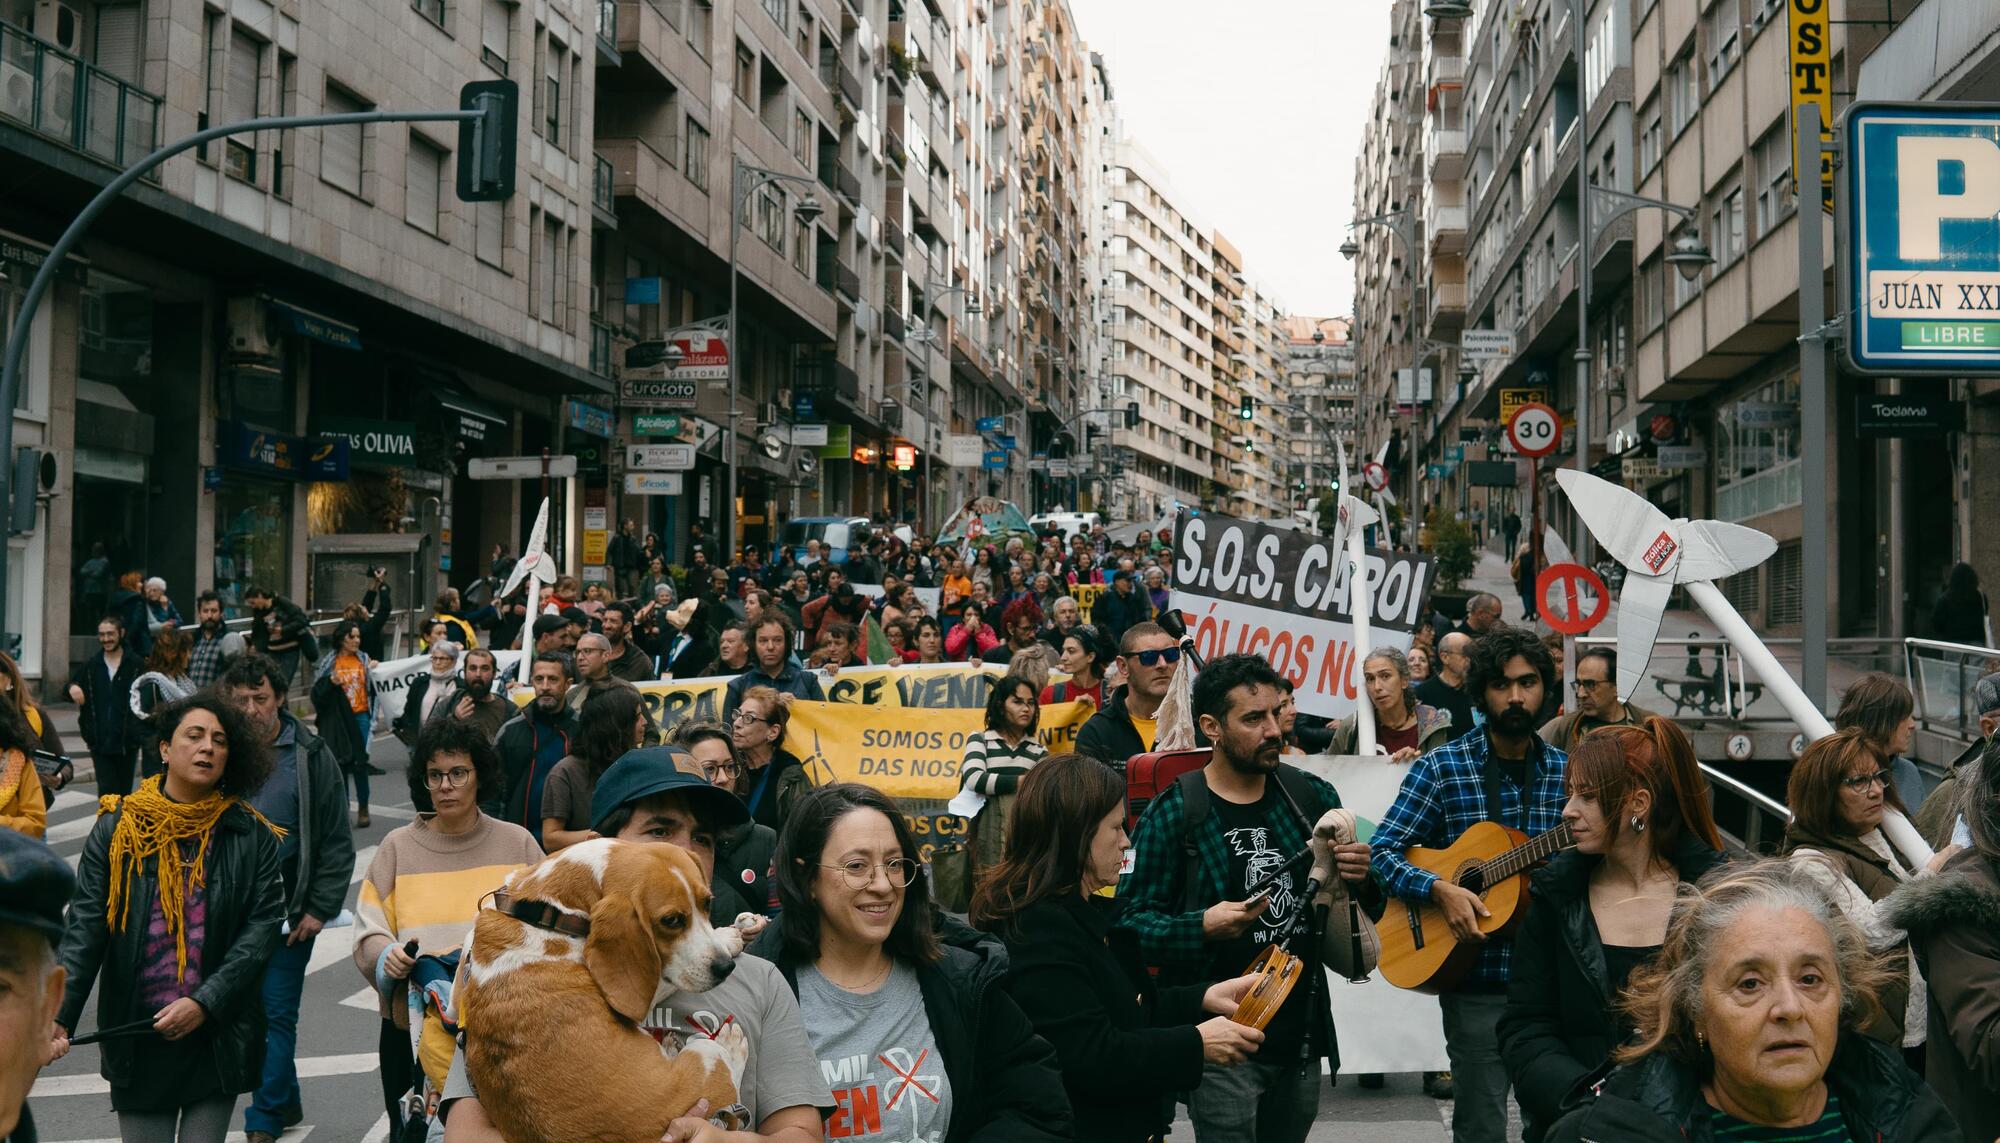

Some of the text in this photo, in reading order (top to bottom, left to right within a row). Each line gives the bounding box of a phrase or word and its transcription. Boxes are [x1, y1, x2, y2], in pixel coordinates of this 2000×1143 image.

[1897, 136, 2000, 260] P
[1879, 283, 1943, 309] JUAN
[1920, 326, 1986, 343] LIBRE
[1519, 421, 1551, 439] 30
[363, 432, 415, 456] OLIVIA
[1177, 518, 1283, 602] S.O.S.
[862, 728, 943, 749] SOMOS
[1038, 722, 1079, 746] NTE
[858, 757, 903, 777] DAS
[821, 1084, 882, 1138] EN
